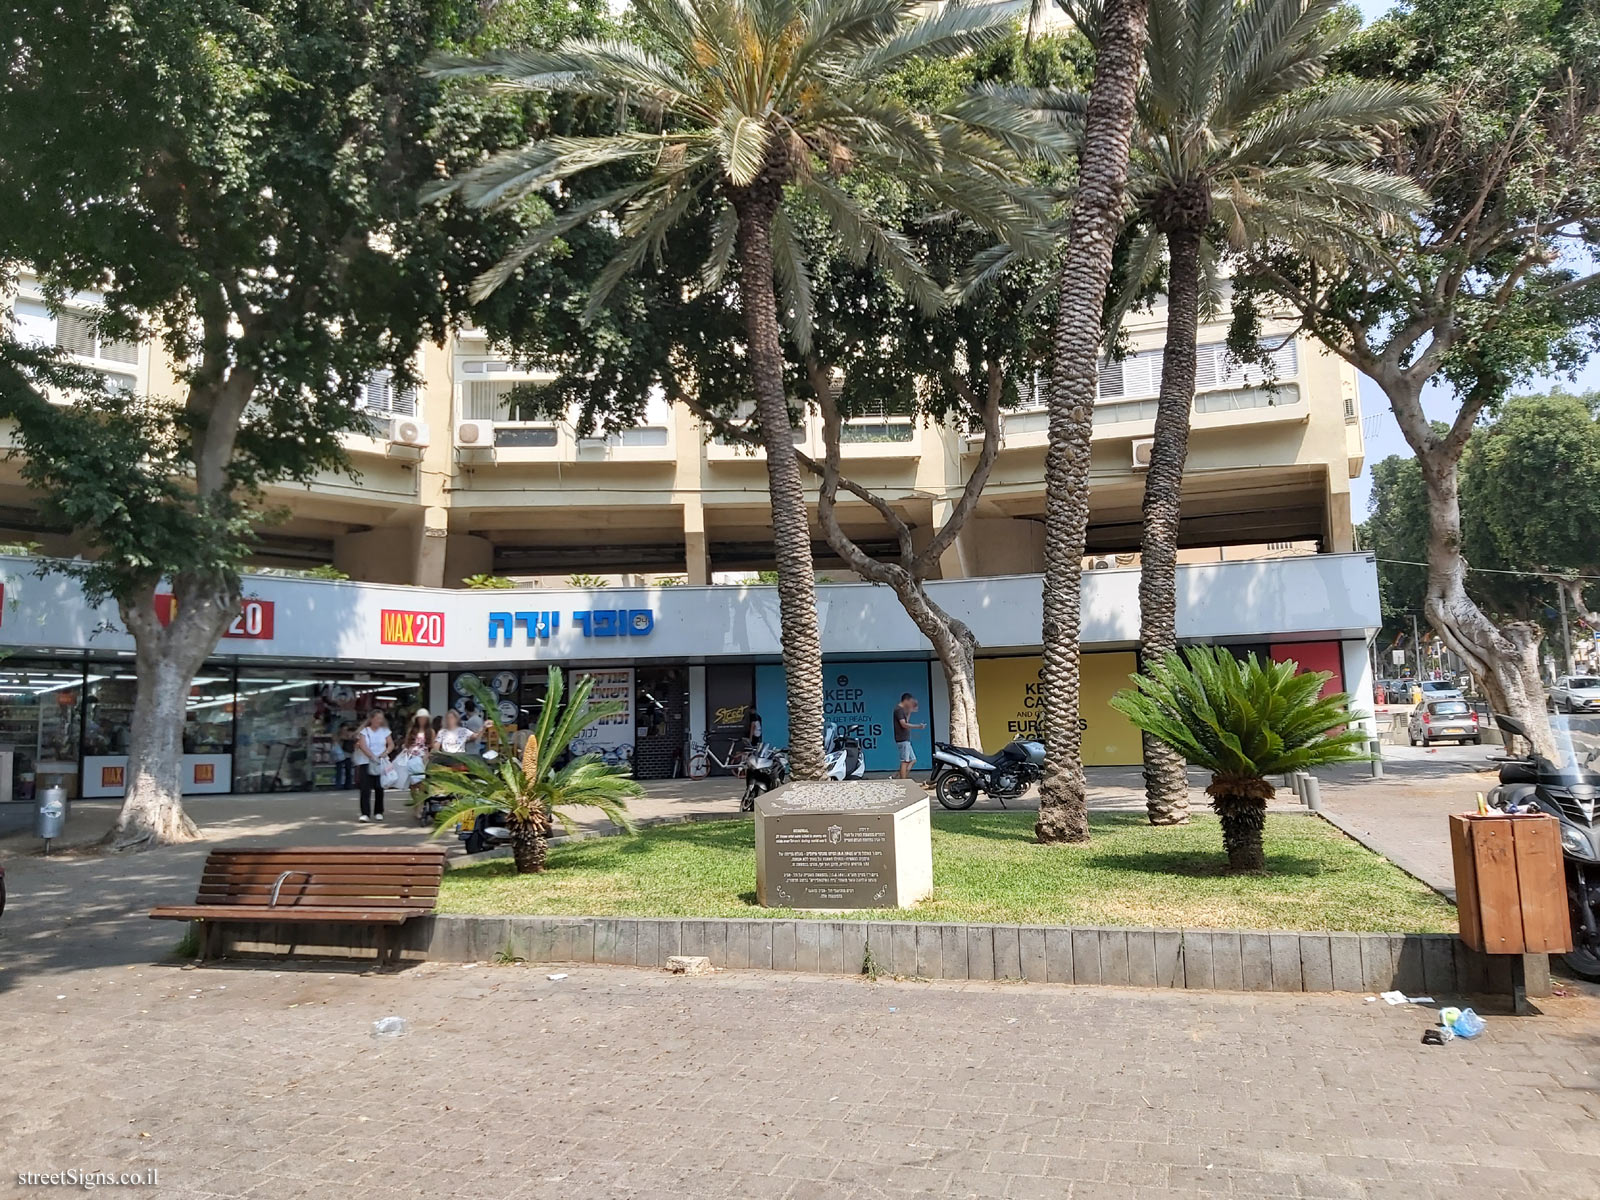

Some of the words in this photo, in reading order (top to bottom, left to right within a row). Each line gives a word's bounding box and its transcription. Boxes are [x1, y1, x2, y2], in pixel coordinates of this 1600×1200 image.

[488, 611, 560, 640] יודה
[573, 609, 655, 637] סופר
[635, 617, 648, 626] 24
[825, 688, 864, 701] KEEP
[1026, 683, 1045, 695] KE
[824, 702, 864, 714] CALM
[1024, 697, 1045, 708] CA
[869, 724, 882, 736] IS
